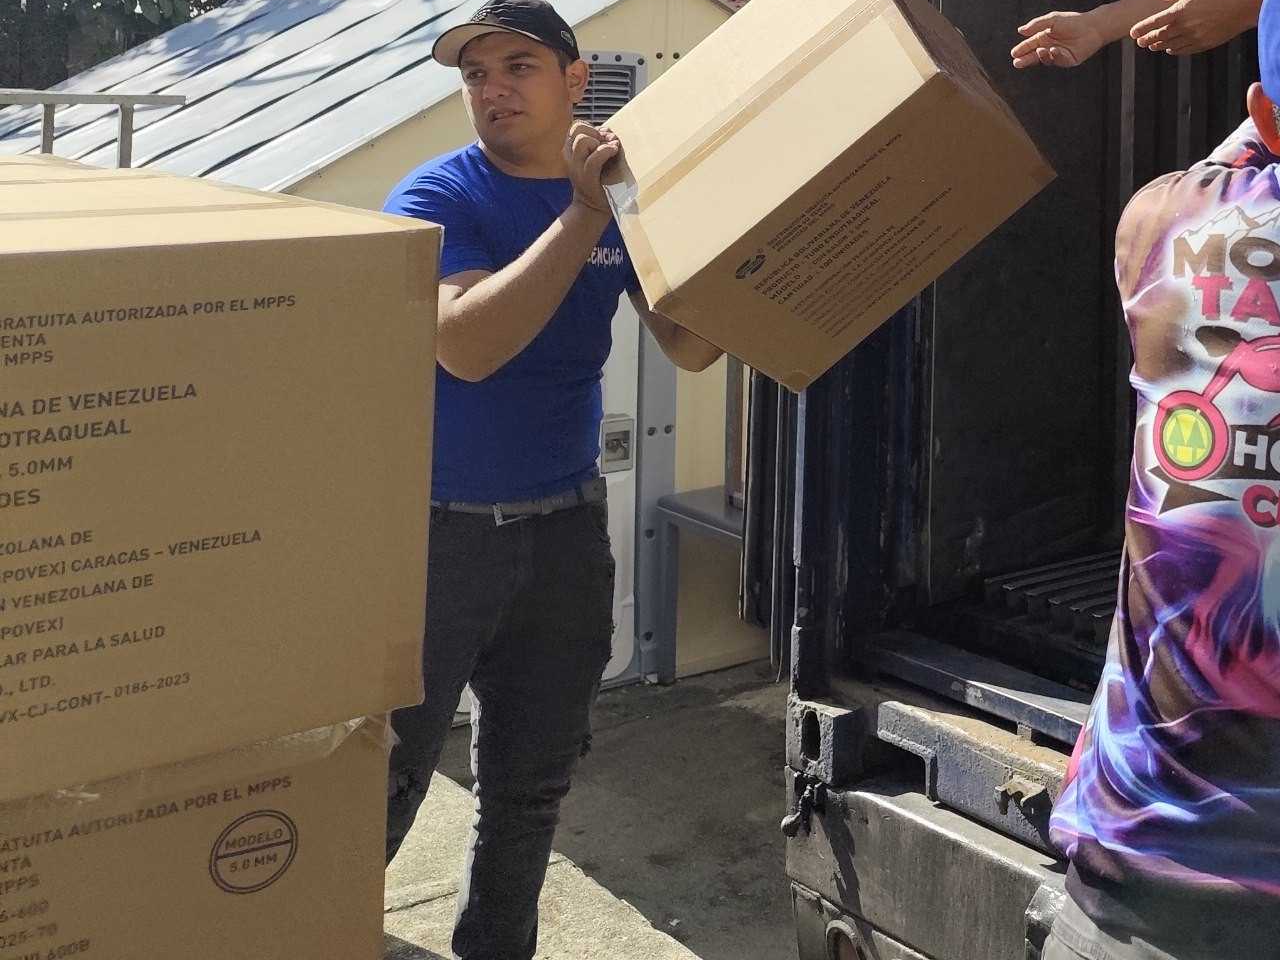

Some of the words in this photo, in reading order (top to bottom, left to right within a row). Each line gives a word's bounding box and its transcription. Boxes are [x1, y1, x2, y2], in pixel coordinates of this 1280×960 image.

[792, 217, 840, 257] BOLIVARIANA
[838, 208, 852, 219] DE
[849, 174, 892, 210] VENEZUELA
[803, 242, 825, 260] TUBO
[823, 196, 880, 244] ENDOTRAQUEAL
[818, 258, 833, 270] 100
[831, 229, 868, 259] UNIDADES
[81, 303, 189, 325] AUTORIZADA
[193, 300, 225, 315] POR
[230, 298, 249, 312] EL
[252, 295, 296, 310] MPPS
[0, 333, 47, 350] ENTA
[4, 350, 54, 367] MPPS
[32, 396, 62, 416] DE
[68, 383, 198, 410] VENEZUELA
[8, 455, 73, 479] 5.0MM
[70, 530, 93, 546] DE
[71, 548, 151, 573] CARACAS
[167, 529, 262, 557] VENEZUELA
[12, 579, 127, 608] VENEZOLANA
[131, 574, 154, 589] DE
[32, 643, 80, 663] PARA
[83, 637, 106, 653] LA
[110, 625, 166, 647] SALUD
[19, 675, 56, 693] LTD.
[68, 802, 179, 838] AUTORIZADA
[184, 792, 217, 812] POR
[222, 788, 242, 802] EL
[247, 776, 292, 797] MPPS
[224, 828, 284, 851] MODELO
[254, 852, 278, 867] MM
